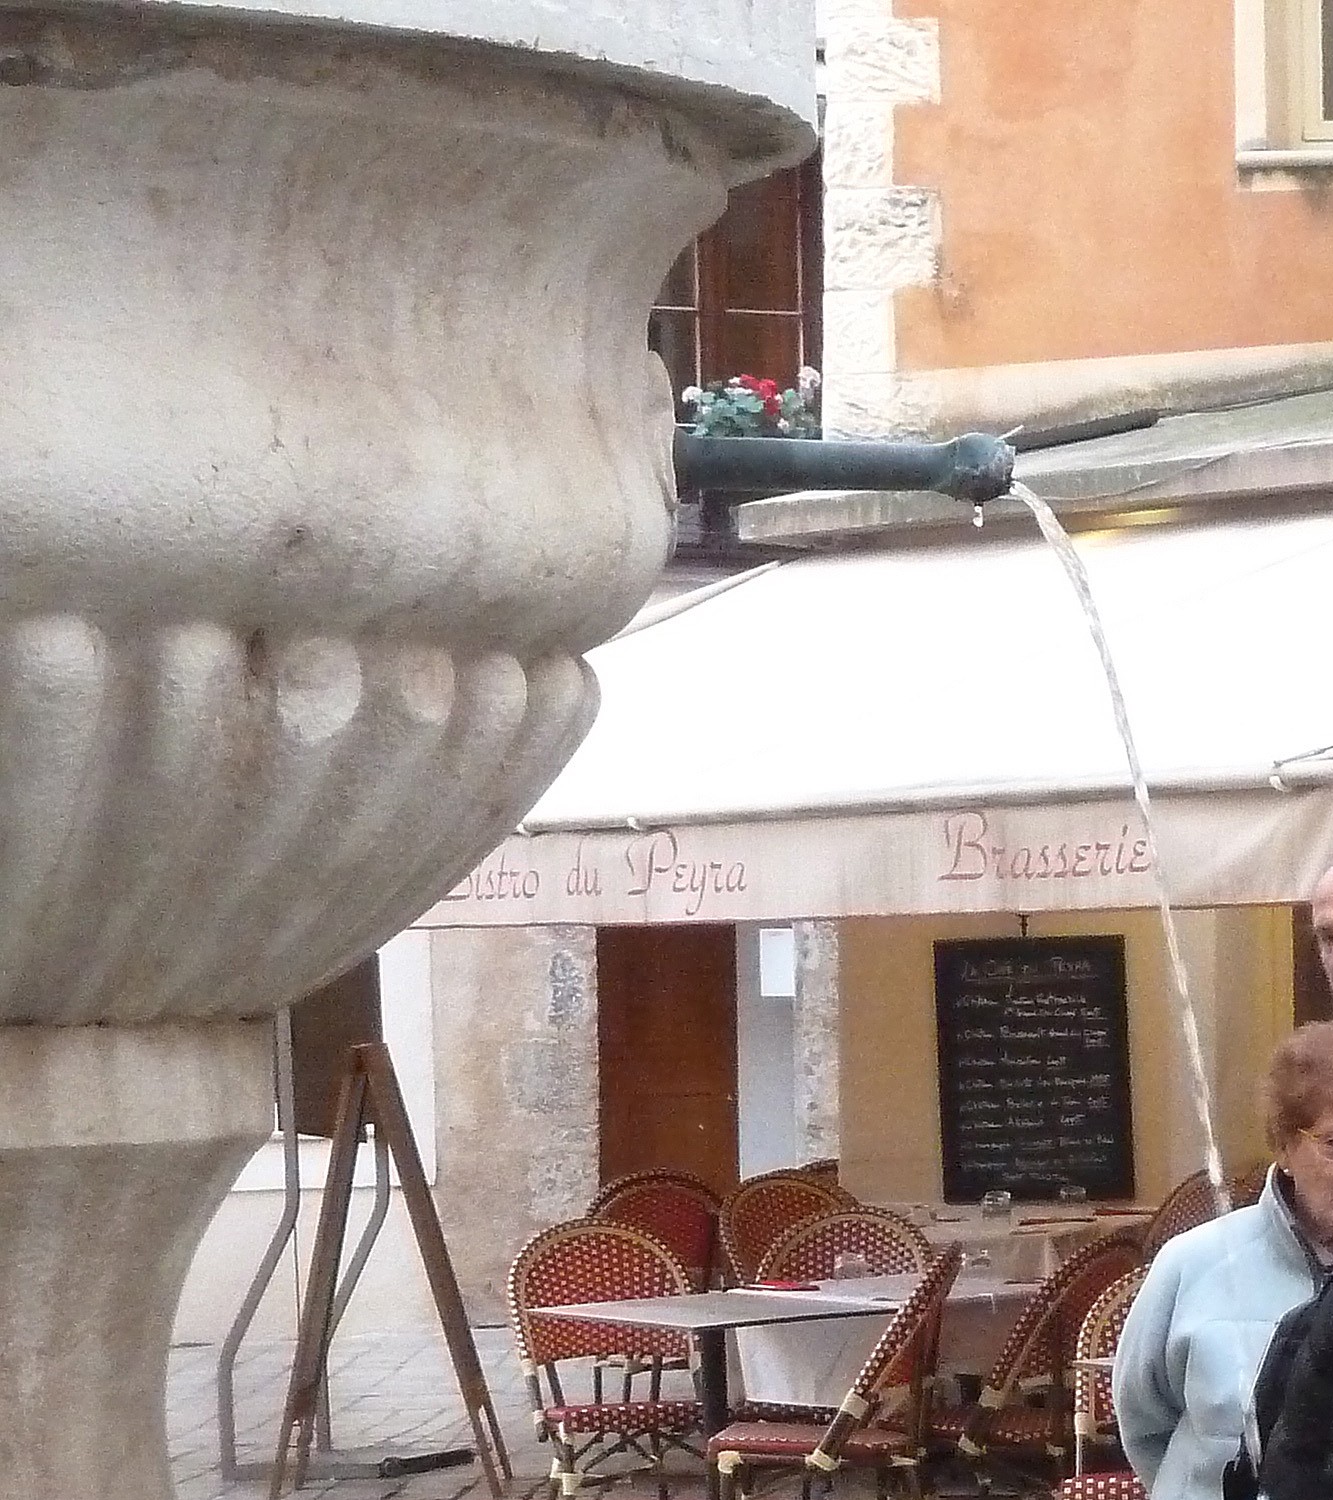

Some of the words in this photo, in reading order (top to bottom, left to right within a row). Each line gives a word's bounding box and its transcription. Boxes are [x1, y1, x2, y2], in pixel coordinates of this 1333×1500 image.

[566, 838, 602, 897] du
[626, 829, 749, 916] Peyra
[937, 810, 1151, 881] Brasserie
